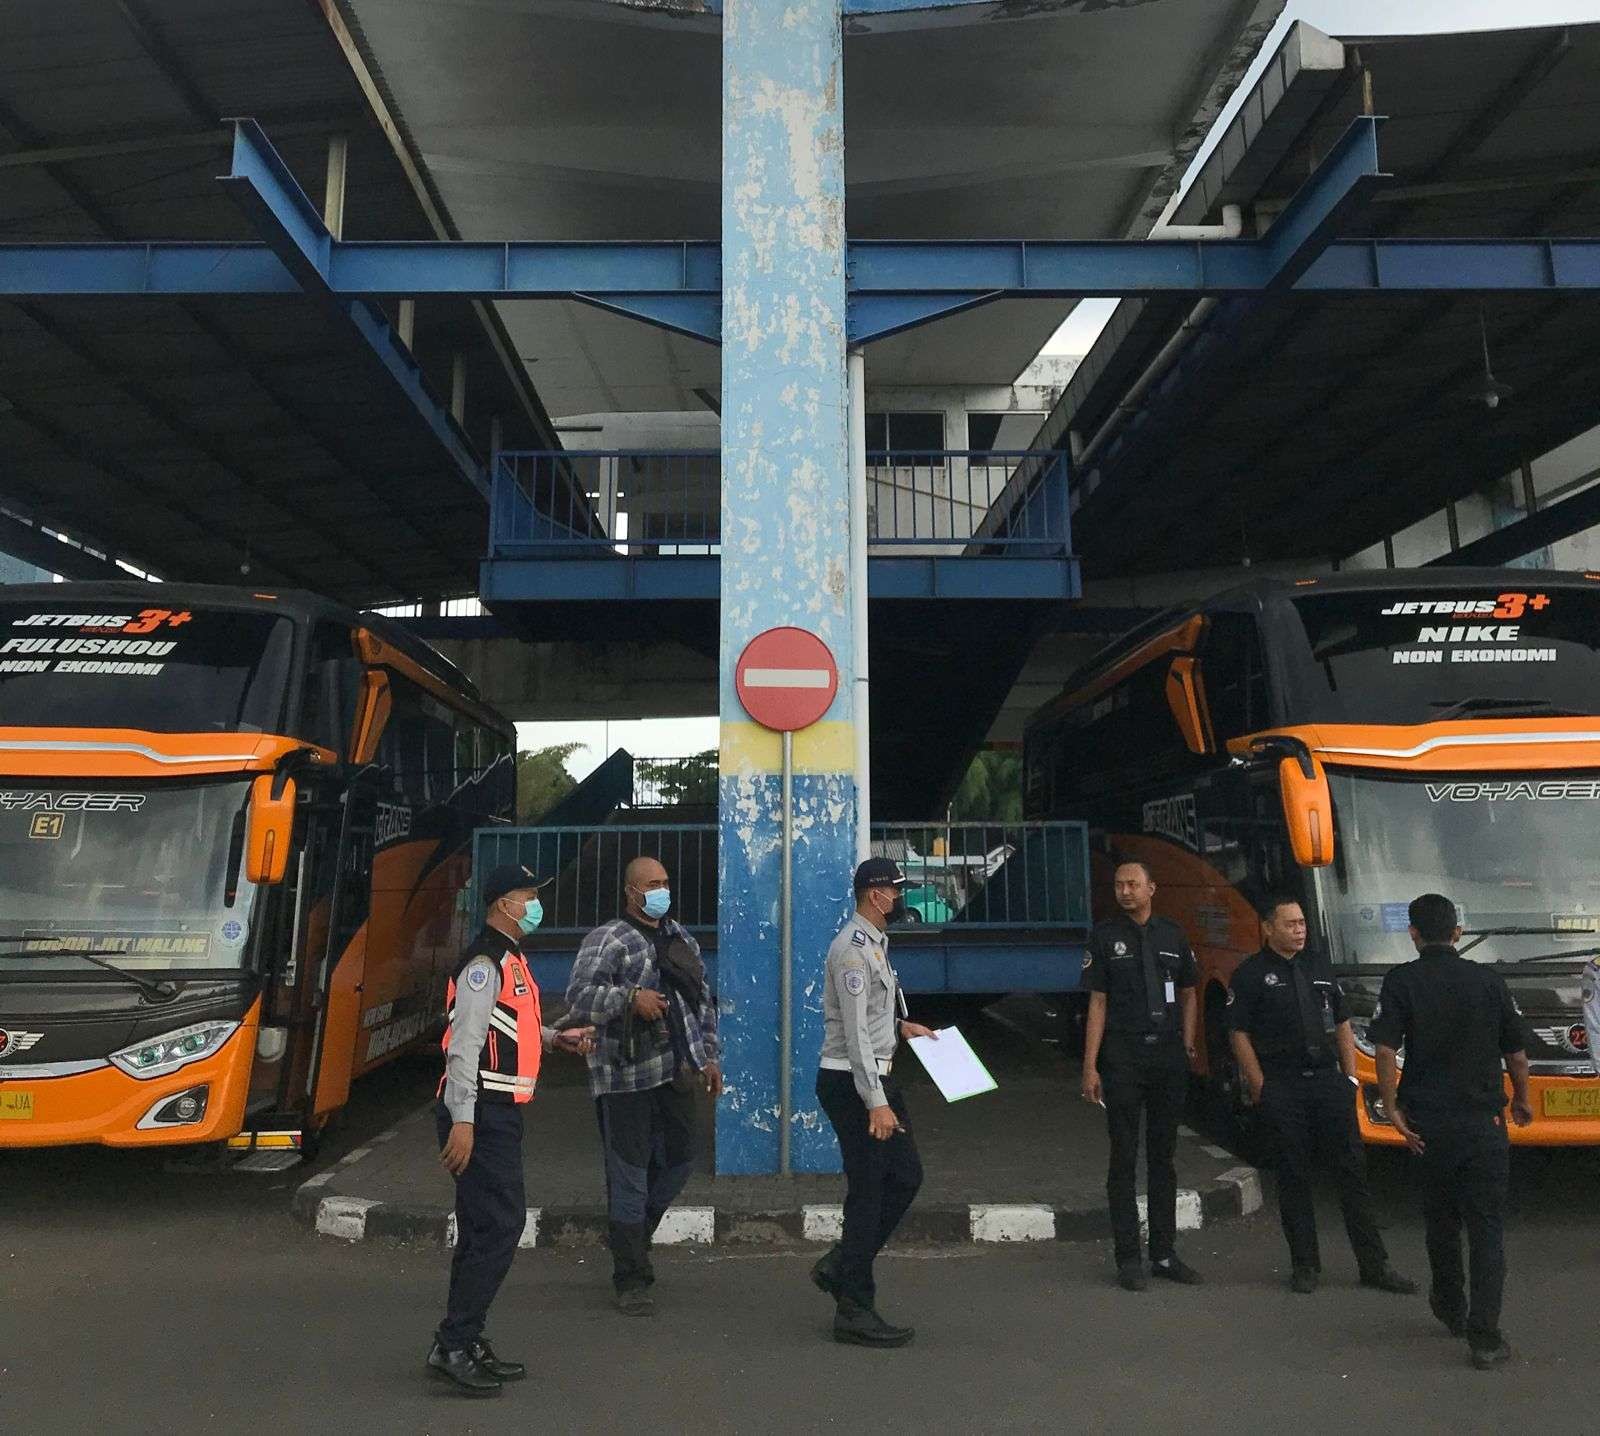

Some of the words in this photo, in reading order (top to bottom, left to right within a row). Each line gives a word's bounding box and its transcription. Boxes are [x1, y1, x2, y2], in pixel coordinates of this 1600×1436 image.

[1381, 600, 1496, 615] JETBUS
[12, 614, 132, 627] JETBUS
[1417, 625, 1520, 643] NIKE
[1, 638, 178, 657] FULUSHOU
[1392, 651, 1443, 664] NON
[1451, 648, 1557, 663] EKONOMI
[0, 660, 51, 673] NON
[53, 660, 165, 676] EKONOMI
[0, 792, 146, 812] YAGER
[34, 816, 61, 834] E1
